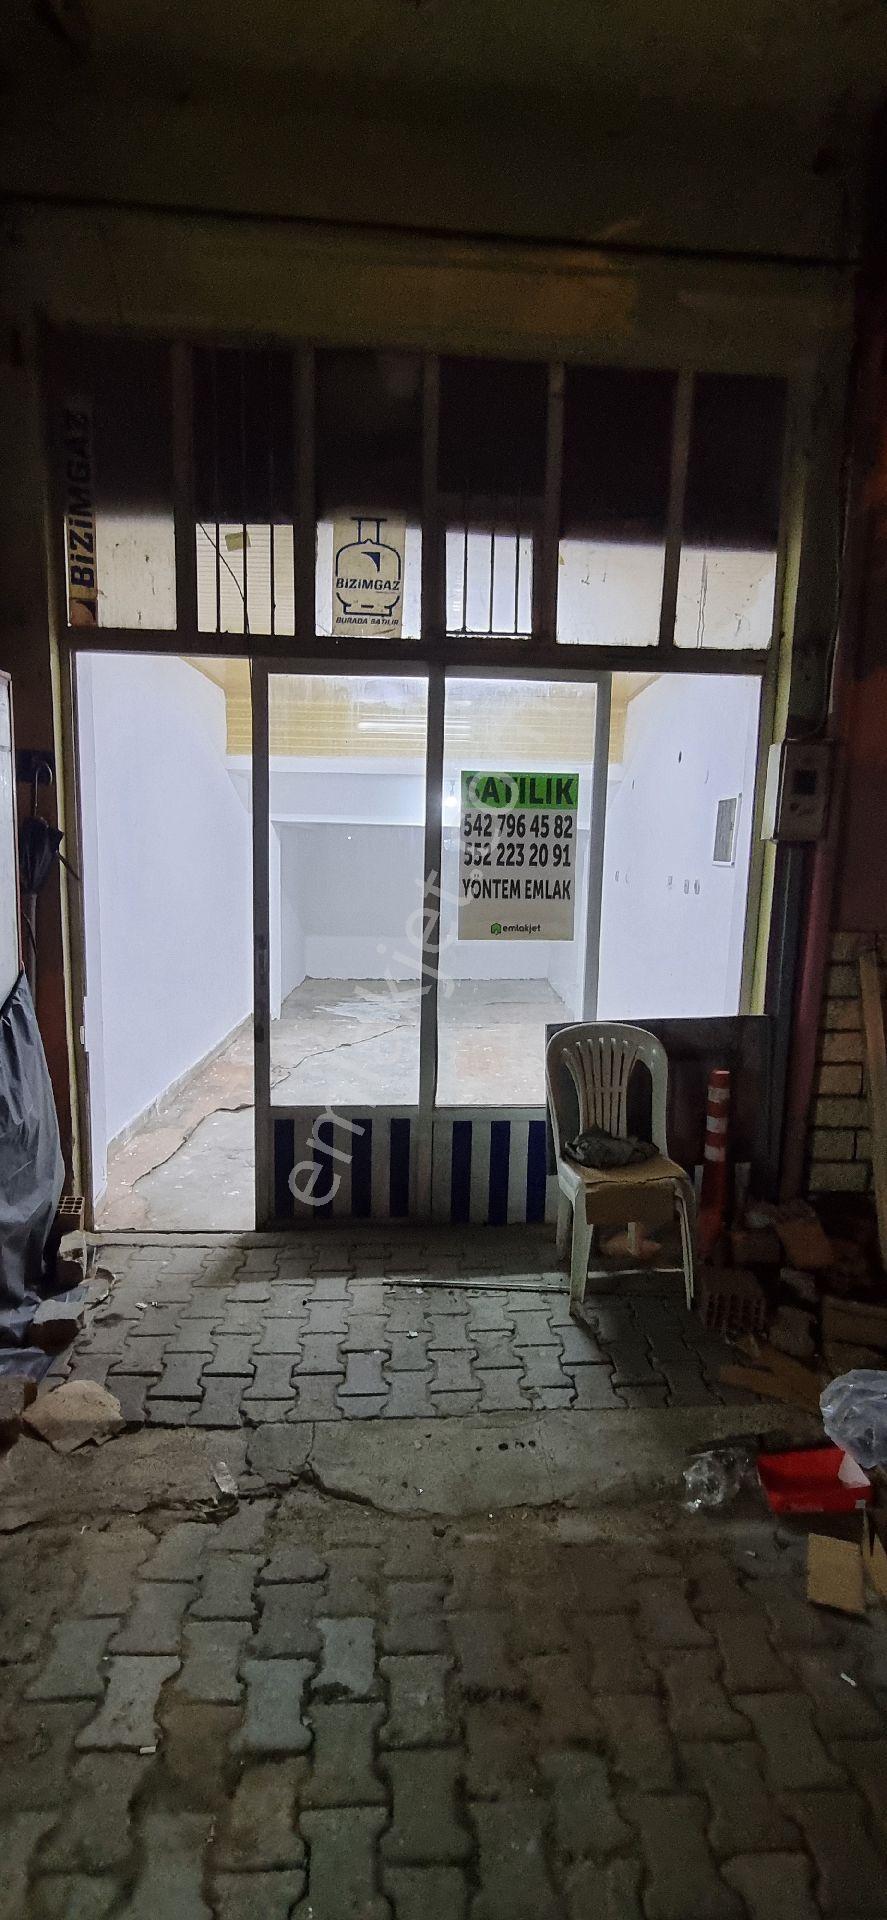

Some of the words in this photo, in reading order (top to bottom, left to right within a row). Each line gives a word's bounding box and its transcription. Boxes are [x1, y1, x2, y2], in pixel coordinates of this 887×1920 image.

[335, 616, 368, 625] BURADA
[464, 776, 574, 805] SATILIK
[463, 813, 493, 837] 542
[497, 814, 526, 839] 796
[530, 814, 549, 839] 45
[553, 815, 573, 839] 82
[463, 842, 492, 867] 552
[496, 843, 525, 867] 223
[528, 843, 549, 868] 20
[552, 843, 571, 868] 91
[462, 873, 521, 900] YÖNTEM
[524, 879, 571, 900] EMLAK
[502, 923, 541, 934] emlakjet
